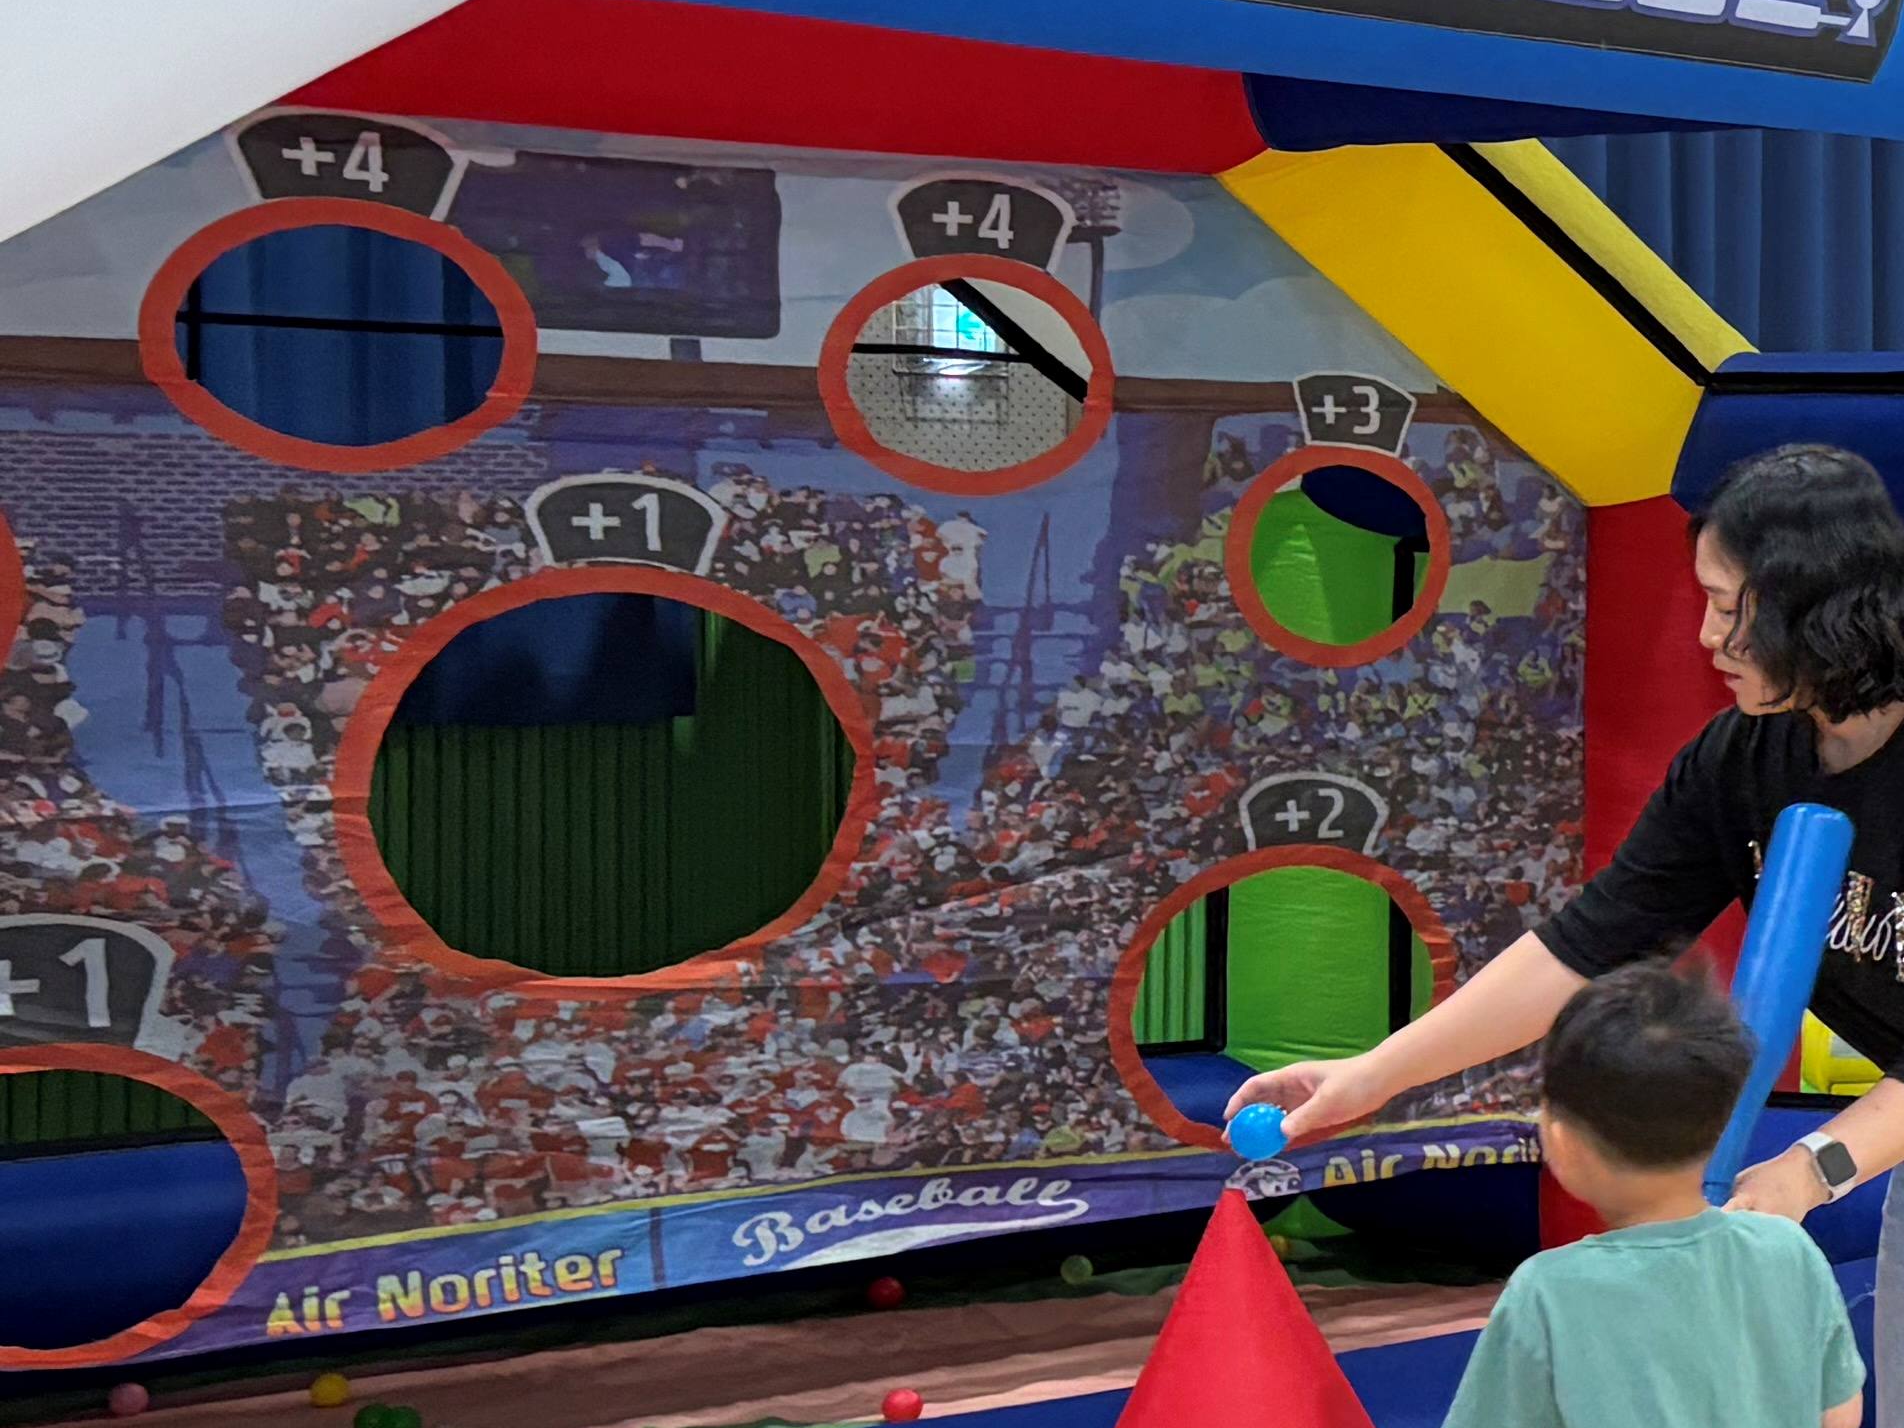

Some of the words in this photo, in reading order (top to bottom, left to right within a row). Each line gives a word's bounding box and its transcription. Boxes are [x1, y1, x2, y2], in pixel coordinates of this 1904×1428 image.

[281, 131, 389, 192] +4
[932, 194, 1014, 249] +4
[1311, 385, 1381, 434] +3
[571, 493, 662, 551] +1
[1275, 788, 1345, 839] +2
[732, 1176, 1080, 1267] Baseball
[266, 1286, 351, 1336] Air
[376, 1246, 623, 1322] Noriter
